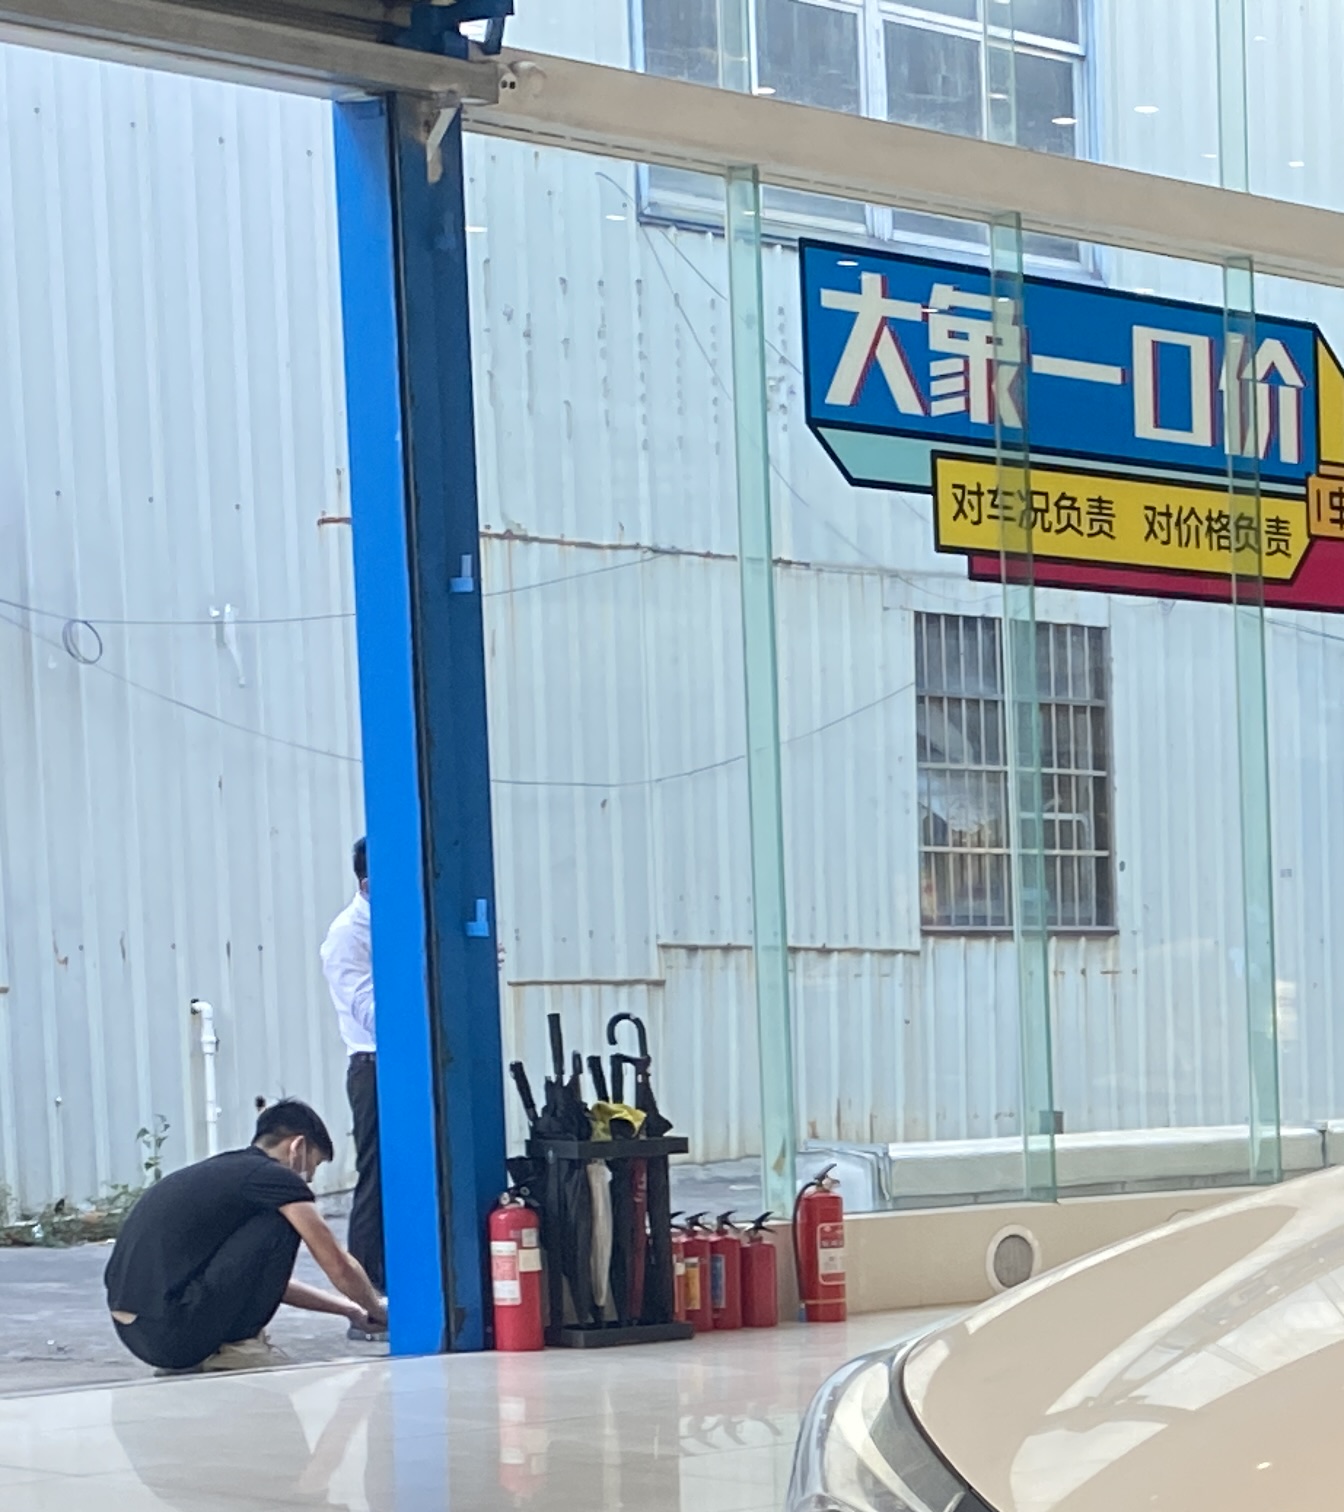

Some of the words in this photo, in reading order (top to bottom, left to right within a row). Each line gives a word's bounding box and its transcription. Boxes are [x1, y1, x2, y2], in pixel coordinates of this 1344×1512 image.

[818, 270, 1306, 465] 大象一口价
[951, 482, 1117, 541] 对车况负责
[1143, 503, 1292, 560] 对价格负责
